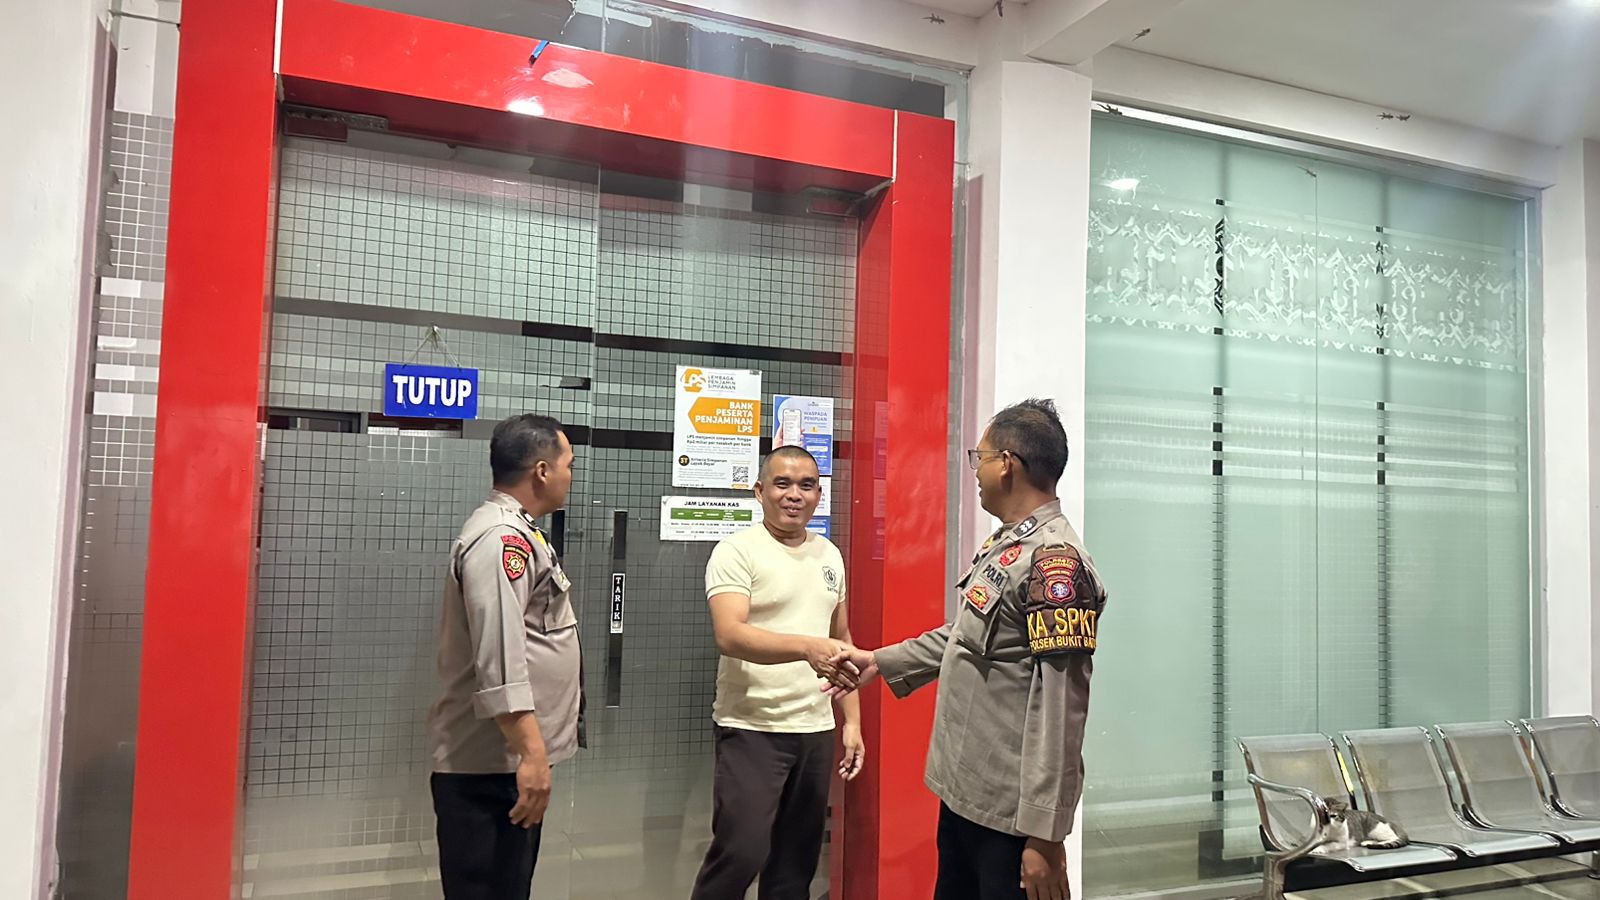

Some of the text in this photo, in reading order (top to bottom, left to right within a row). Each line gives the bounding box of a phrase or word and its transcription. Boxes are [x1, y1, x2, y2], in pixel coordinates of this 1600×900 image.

[392, 375, 471, 407] TUTUP
[730, 401, 753, 410] BANK
[716, 408, 753, 418] PESERTA
[695, 415, 753, 425] PENJAMINAN
[737, 425, 753, 433] LPS
[982, 563, 1005, 587] POLRI
[613, 576, 622, 620] TARIK
[1026, 607, 1097, 641] KA SPKT
[1056, 635, 1083, 648] BUKIT
